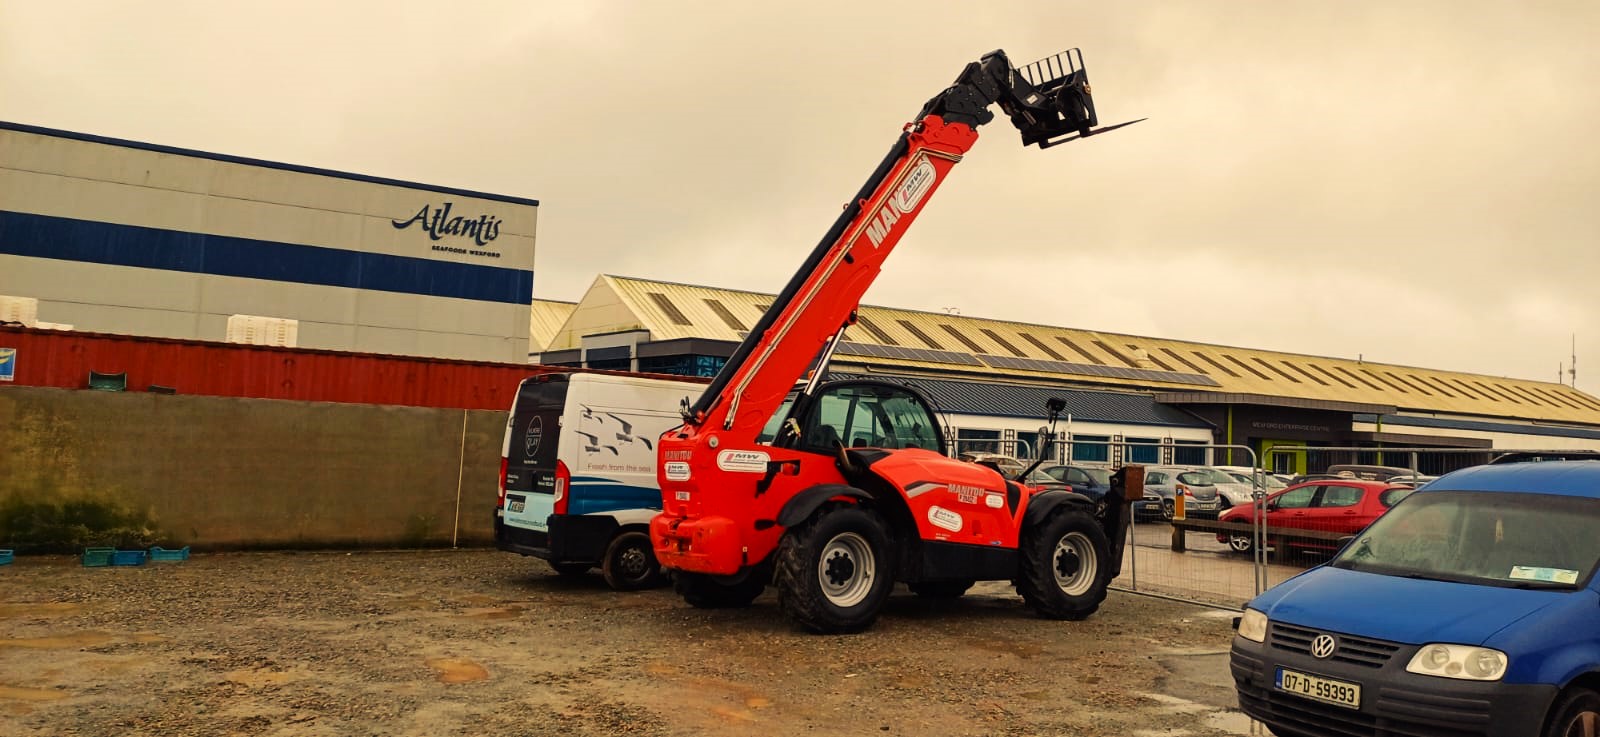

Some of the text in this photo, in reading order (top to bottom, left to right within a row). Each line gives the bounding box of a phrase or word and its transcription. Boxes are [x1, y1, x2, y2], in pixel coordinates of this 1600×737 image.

[392, 203, 502, 246] Atlantis
[432, 246, 467, 254] SEAFOODS
[948, 483, 985, 497] MANITOU
[1284, 674, 1355, 702] 07-D-59393
